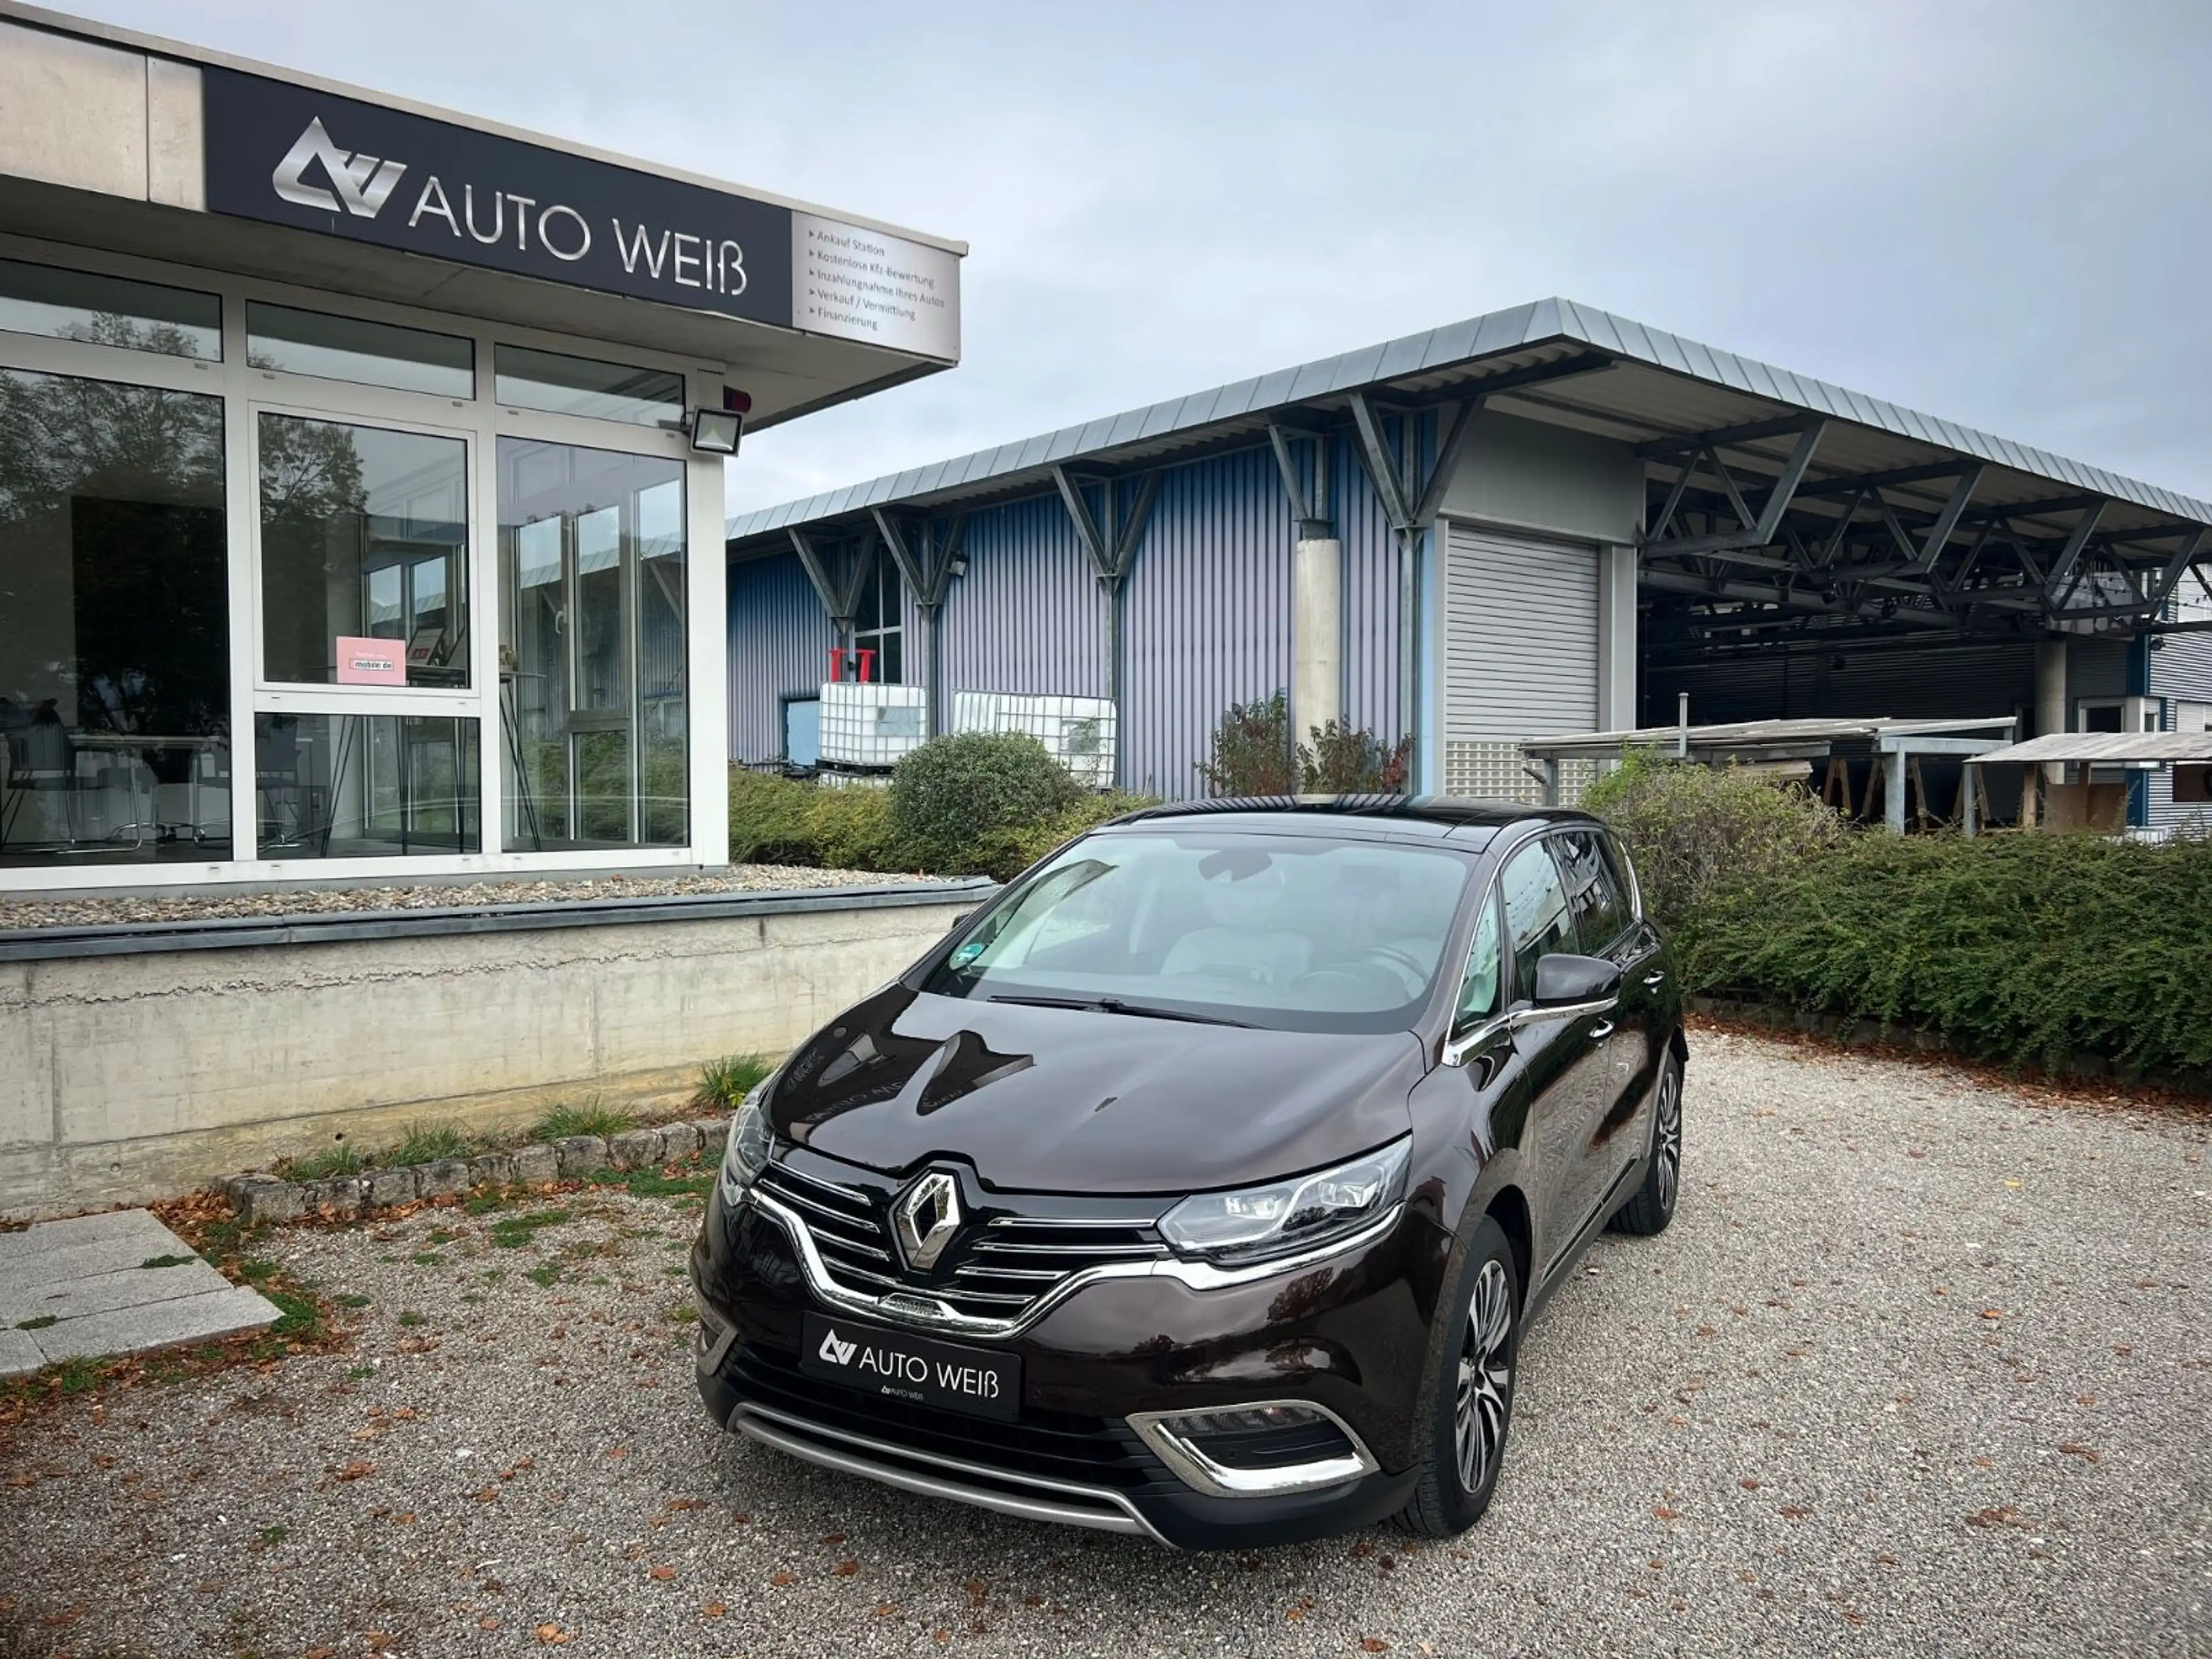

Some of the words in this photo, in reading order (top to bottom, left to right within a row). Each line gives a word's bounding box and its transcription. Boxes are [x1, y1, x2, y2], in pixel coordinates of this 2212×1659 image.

[408, 176, 592, 262] AUTO
[612, 218, 747, 296] WEIß
[817, 232, 850, 248] Ankauf
[853, 240, 885, 257] Station
[817, 251, 868, 271] Kostenlose
[870, 261, 934, 289] Kfz-Bewertung
[818, 270, 894, 296] Inzahlungnahme
[896, 289, 918, 302] Ihres
[919, 295, 945, 308] Autos
[817, 290, 855, 306] Verkauf
[863, 299, 916, 321] Vermittlung
[819, 308, 878, 331] Finanzierung
[858, 1347, 929, 1382] AUTO
[936, 1362, 999, 1399] WEIß
